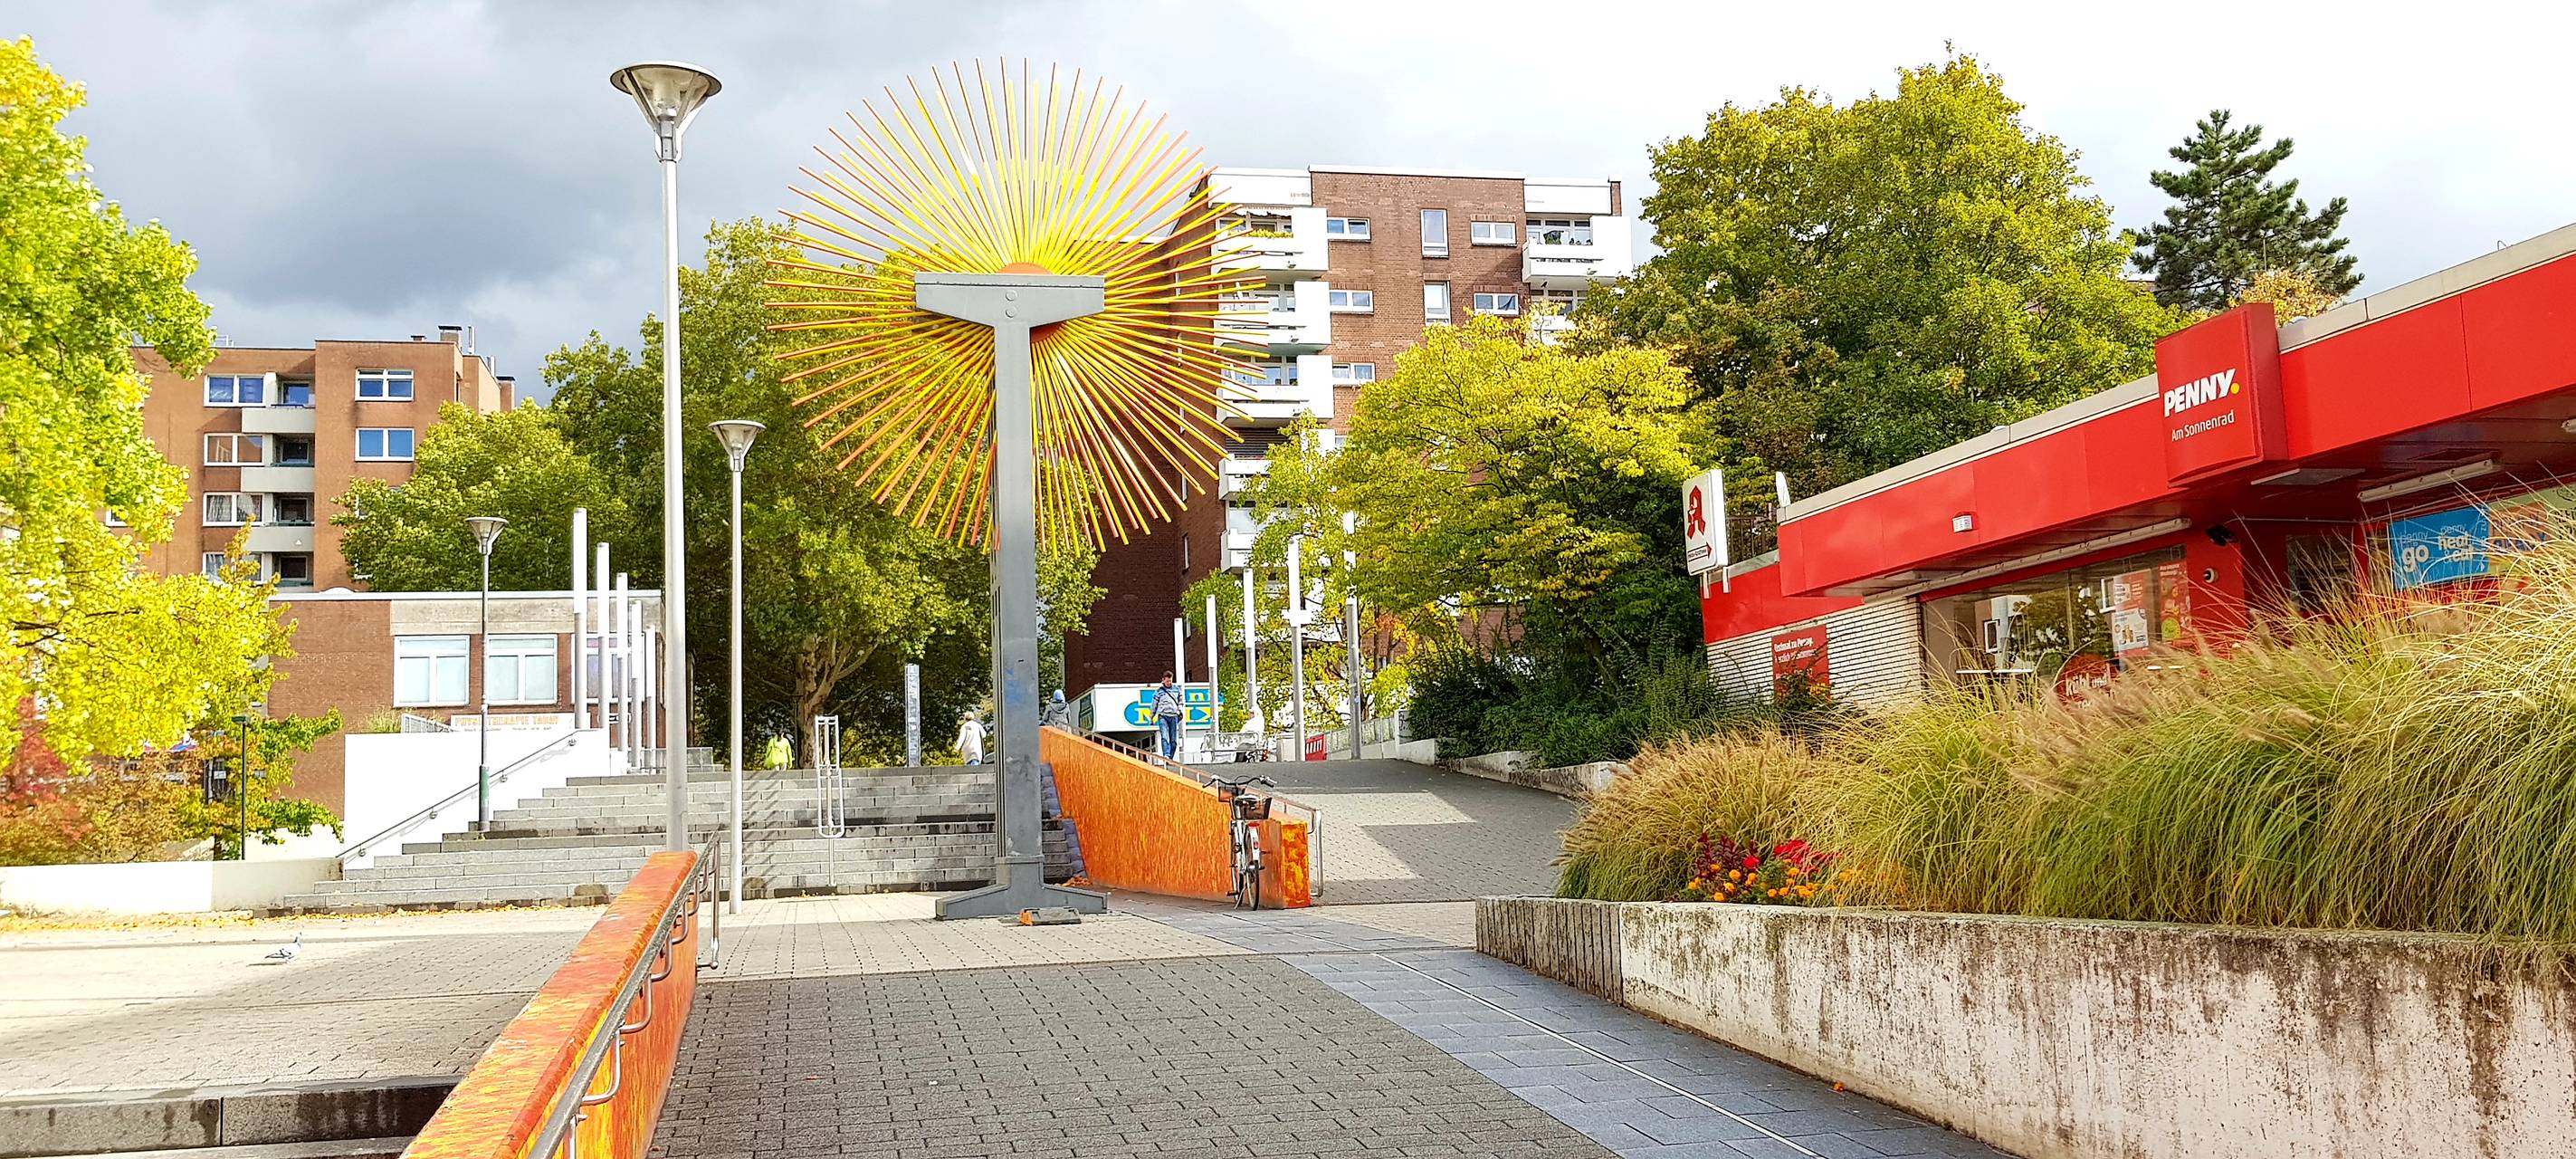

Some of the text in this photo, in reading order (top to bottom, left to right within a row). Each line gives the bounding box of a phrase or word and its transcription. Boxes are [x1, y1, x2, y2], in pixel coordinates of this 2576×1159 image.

[2171, 409, 2235, 442] Am Sonnenrad
[2402, 544, 2429, 572] go
